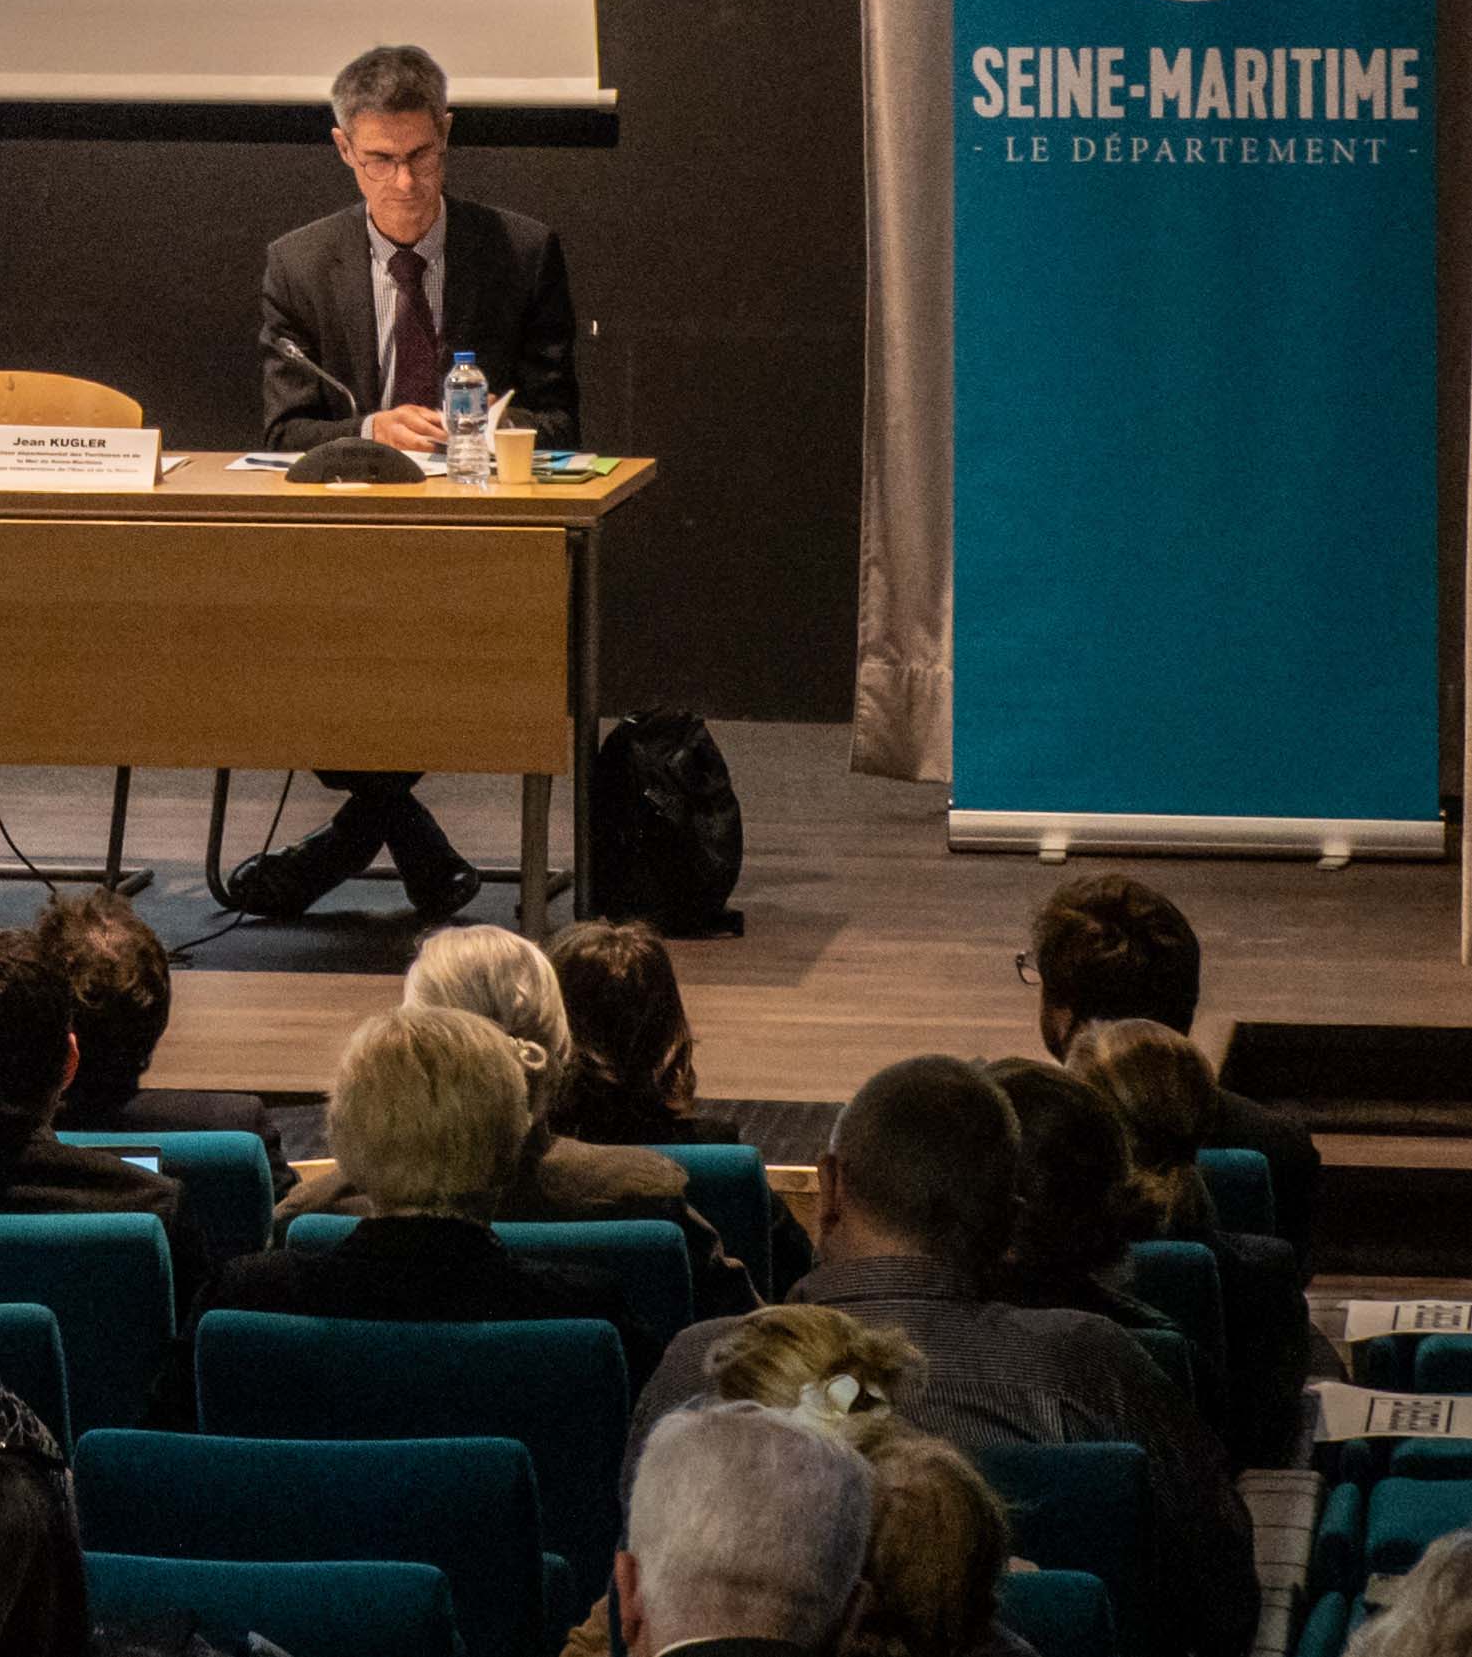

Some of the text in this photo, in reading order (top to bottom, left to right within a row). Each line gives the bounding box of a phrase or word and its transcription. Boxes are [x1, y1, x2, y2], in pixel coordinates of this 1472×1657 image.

[972, 46, 1420, 120] SEINE-MARITIME
[1006, 132, 1388, 164] LE DÉPARTEMENT
[12, 437, 107, 448] Jean KUGLER
